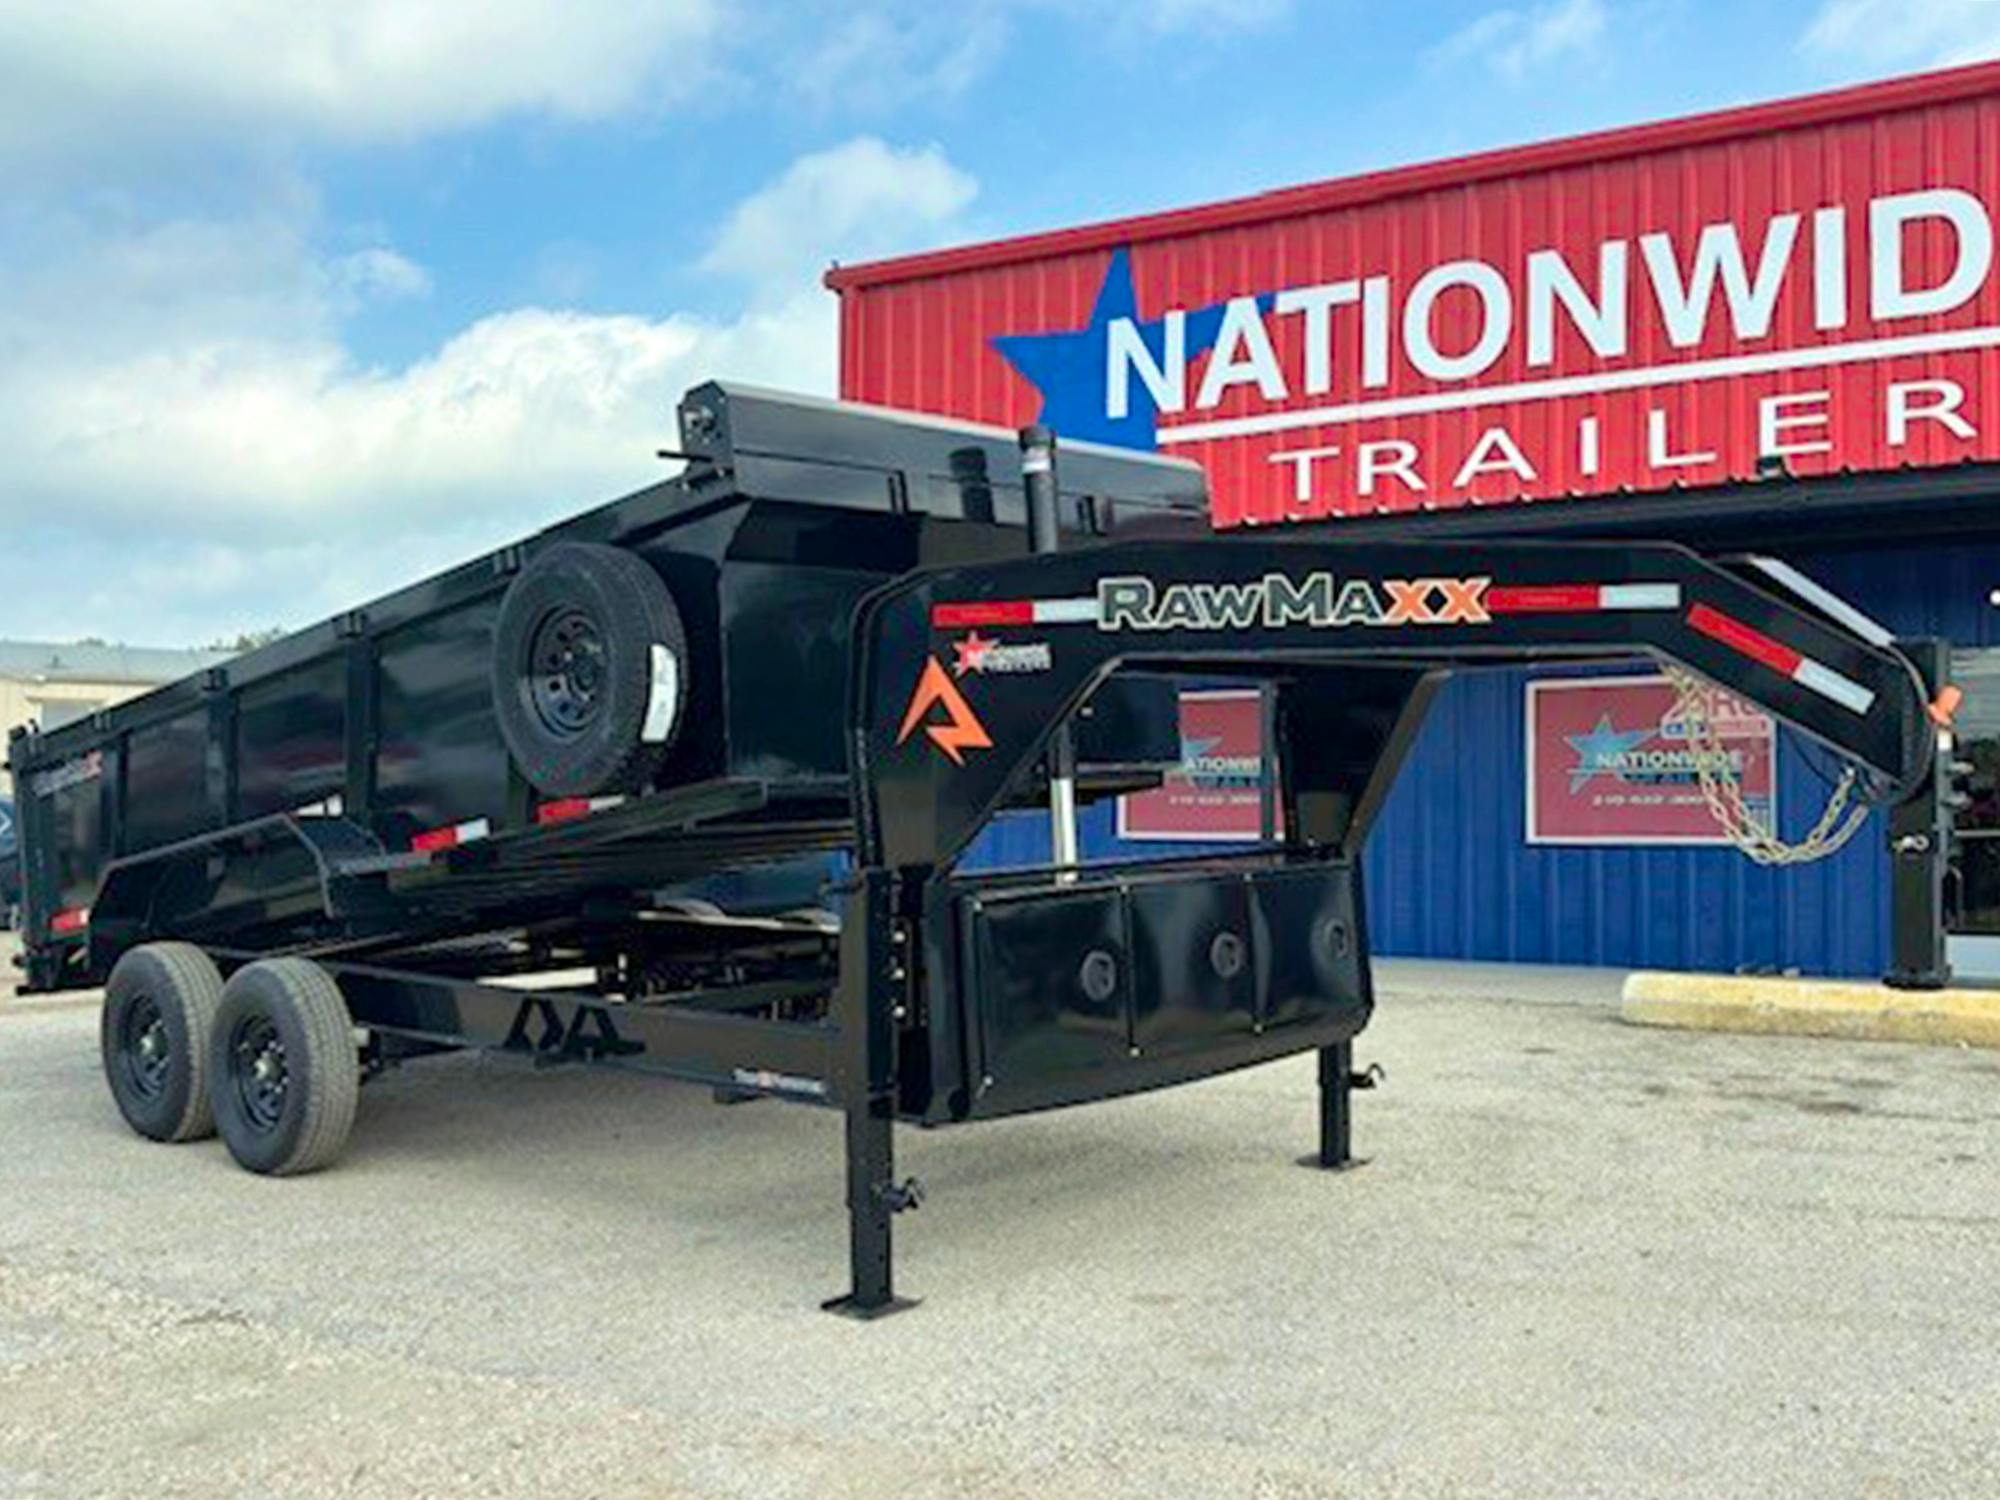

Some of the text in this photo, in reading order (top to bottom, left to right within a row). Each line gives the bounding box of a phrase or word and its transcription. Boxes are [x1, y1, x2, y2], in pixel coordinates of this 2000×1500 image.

[1106, 187, 1994, 419] NATIONWID
[1267, 379, 1977, 501] TRAILER
[1596, 750, 1743, 769] NATIONWDE
